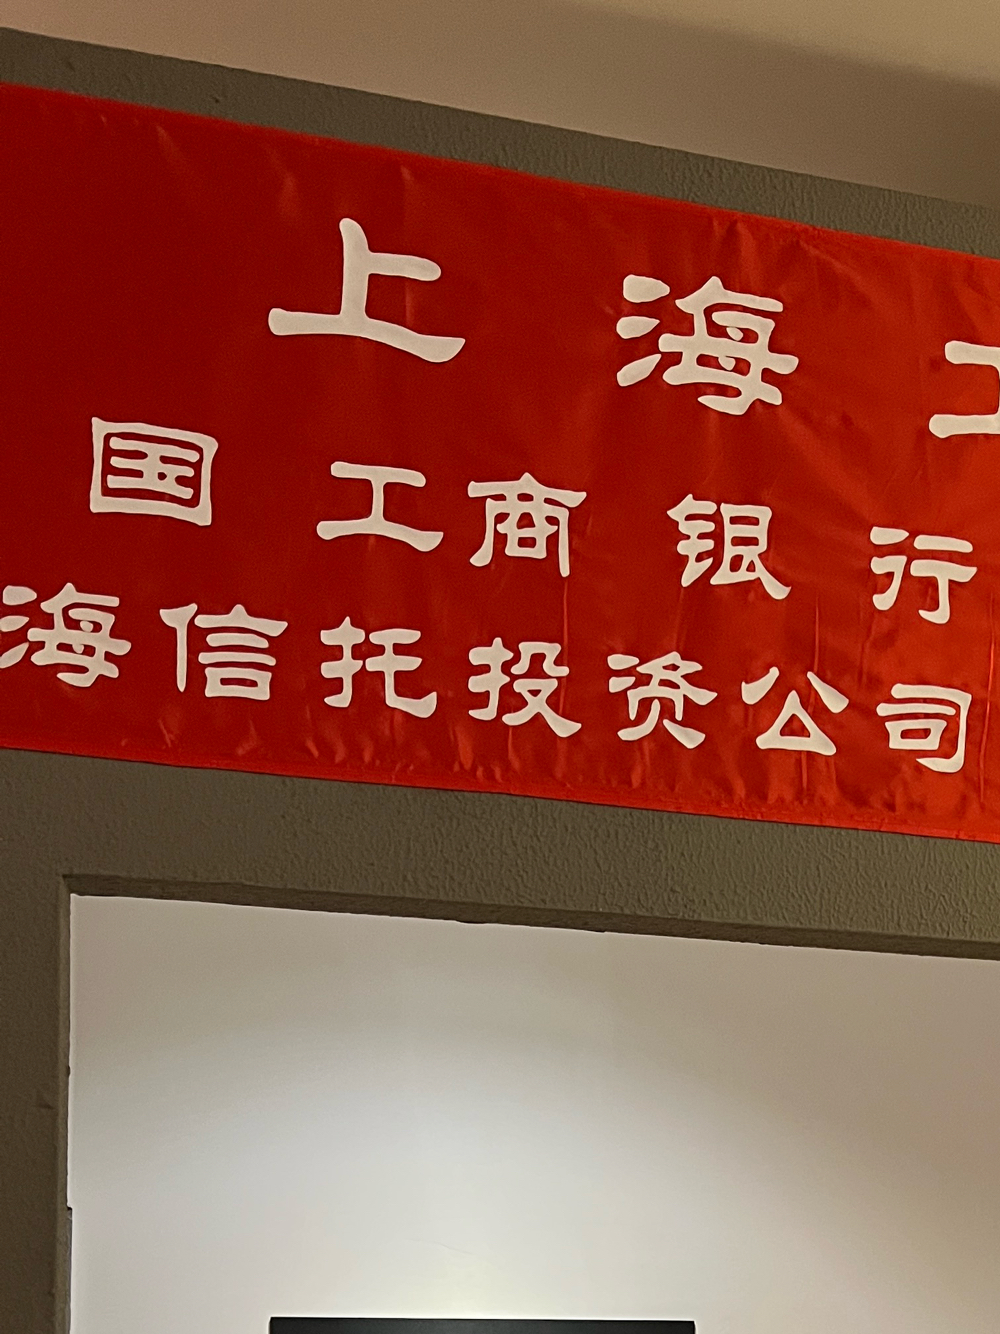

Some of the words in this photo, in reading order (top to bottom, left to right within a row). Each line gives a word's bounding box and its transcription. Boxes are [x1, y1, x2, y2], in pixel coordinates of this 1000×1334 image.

[89, 416, 978, 625] 国工商银行
[0, 582, 973, 774] 海信托投资公司
